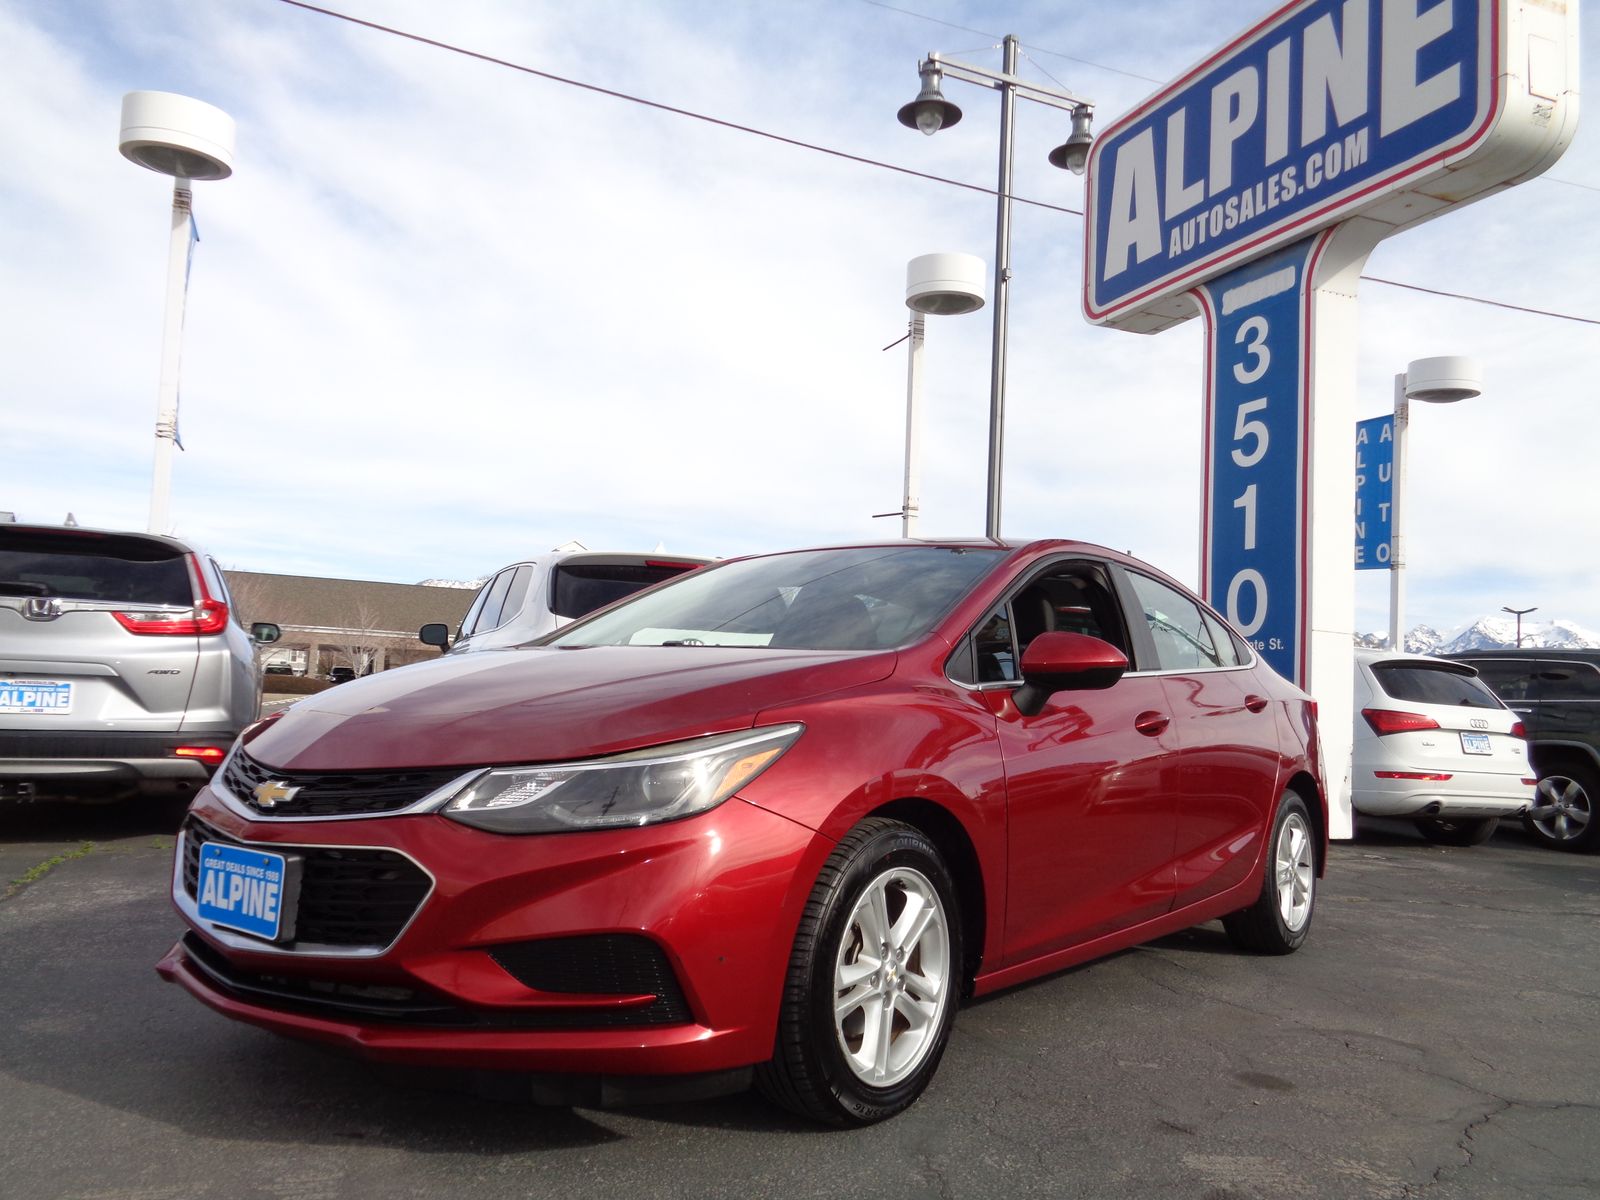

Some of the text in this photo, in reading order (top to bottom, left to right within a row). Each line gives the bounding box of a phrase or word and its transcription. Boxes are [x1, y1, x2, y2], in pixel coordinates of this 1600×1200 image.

[1103, 0, 1461, 282] ALPINE
[1169, 127, 1369, 259] AUTOSALES.COM
[1268, 637, 1284, 650] St.
[0, 690, 69, 707] ALPINE
[201, 870, 278, 922] ALPINE
